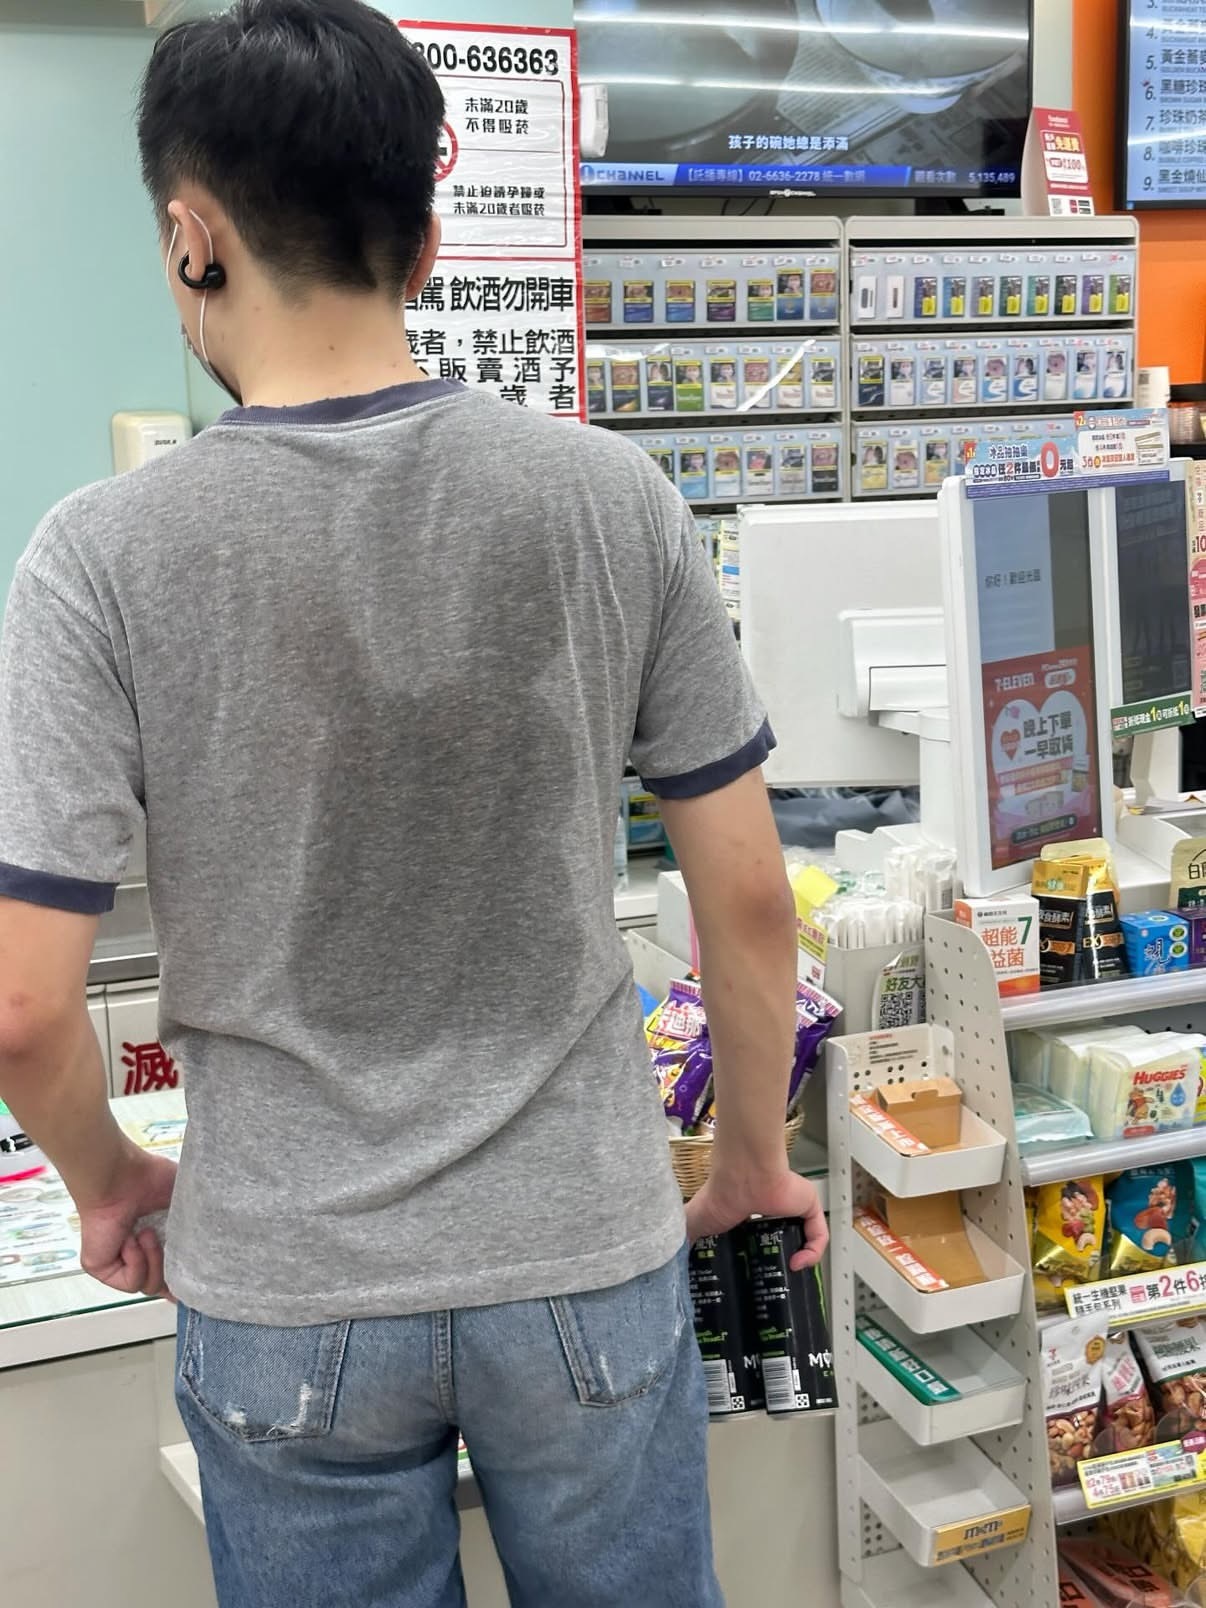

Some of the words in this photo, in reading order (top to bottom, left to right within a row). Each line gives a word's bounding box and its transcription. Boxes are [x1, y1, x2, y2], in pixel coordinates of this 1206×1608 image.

[1145, 55, 1157, 70] 5.
[1144, 86, 1157, 100] 6.
[465, 97, 529, 115] 未滿20歲
[465, 117, 529, 135] 不得吸菸
[1144, 116, 1155, 131] 7.
[749, 170, 820, 182] 02-6636-2278
[1143, 176, 1154, 191] 9.
[453, 202, 546, 217] 未滿20歲者吸菸
[450, 275, 575, 312] 飲酒勿開車
[981, 926, 1018, 947] 超能
[1017, 916, 1033, 945] 7
[121, 1041, 178, 1096] 滅
[1133, 1068, 1188, 1086] HUGGIES
